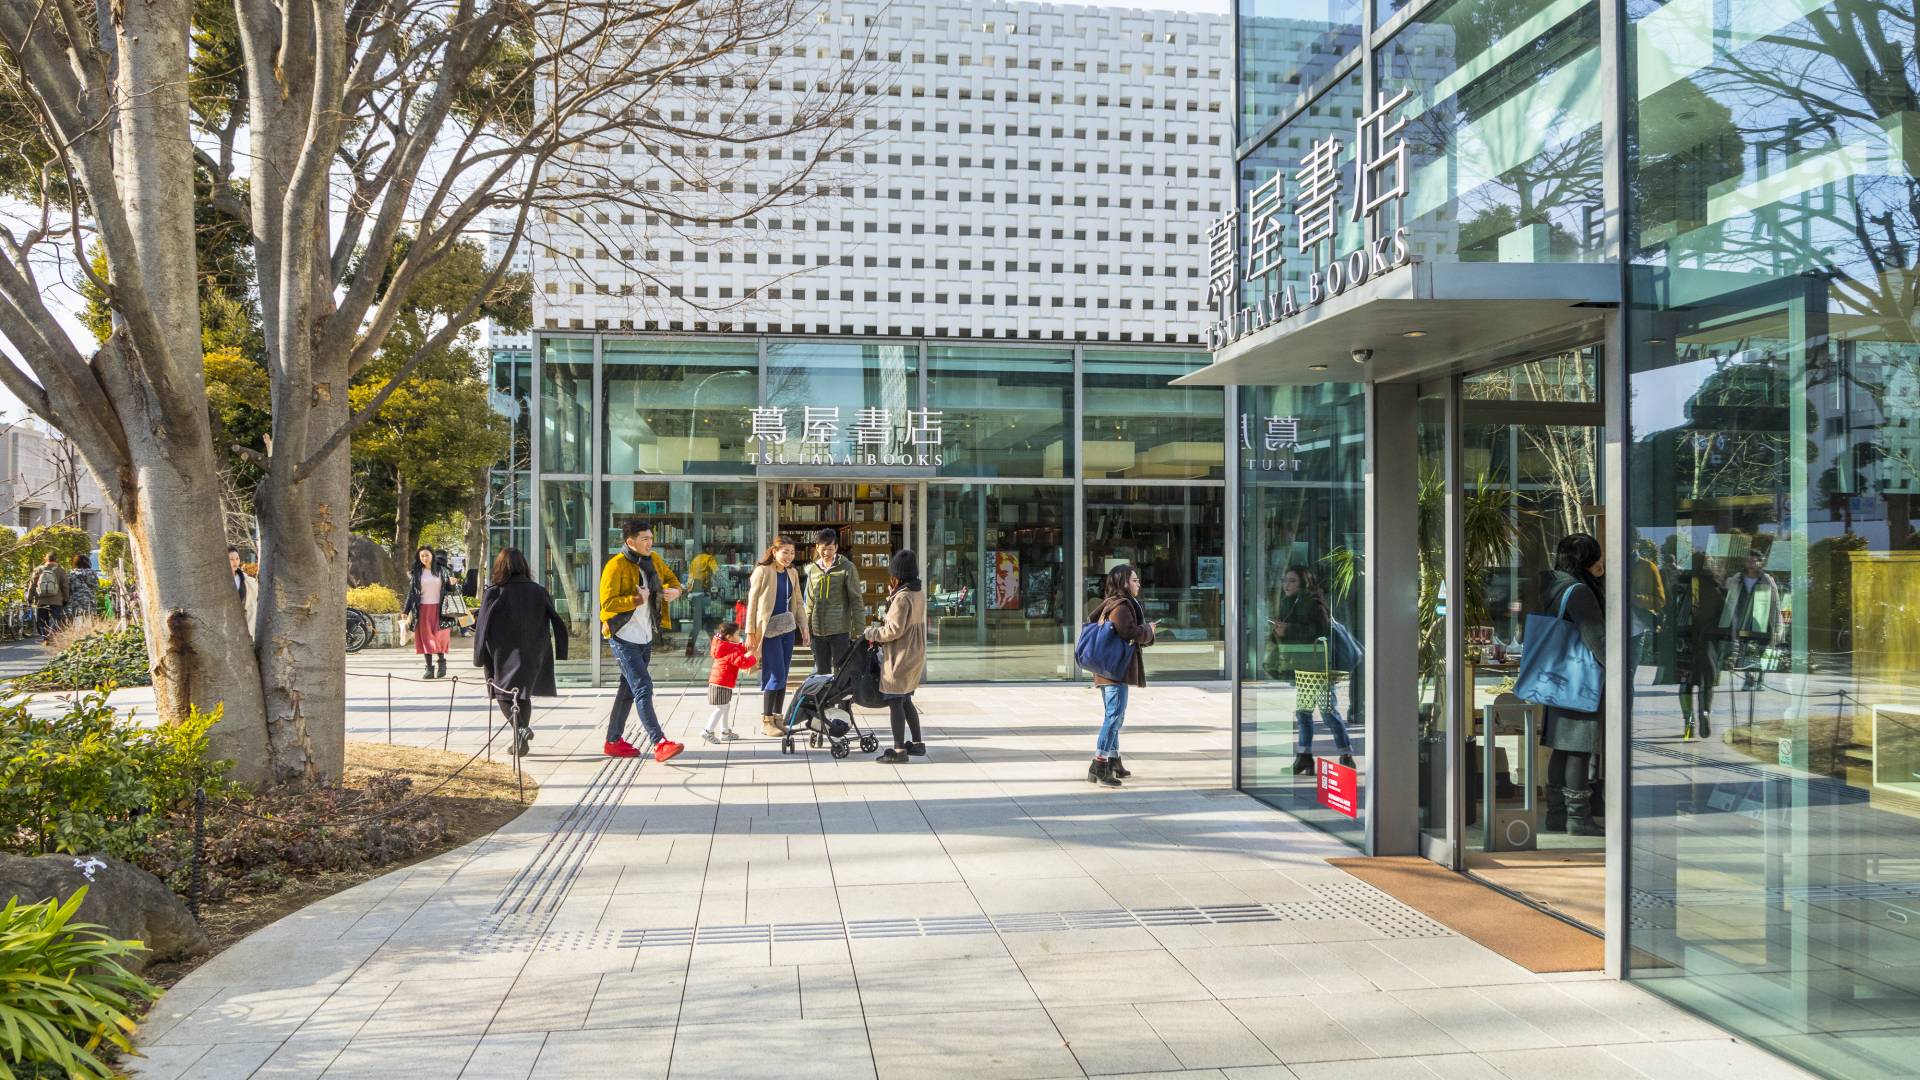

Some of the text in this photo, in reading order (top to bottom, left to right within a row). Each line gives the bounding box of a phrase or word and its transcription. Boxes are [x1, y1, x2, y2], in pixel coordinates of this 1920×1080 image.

[1205, 85, 1413, 305] 蔦屋書店
[1205, 226, 1412, 351] TSUTAYA BOOKS
[746, 405, 943, 446] 蔦屋書店
[746, 452, 944, 466] TSUTAYA BOOKS
